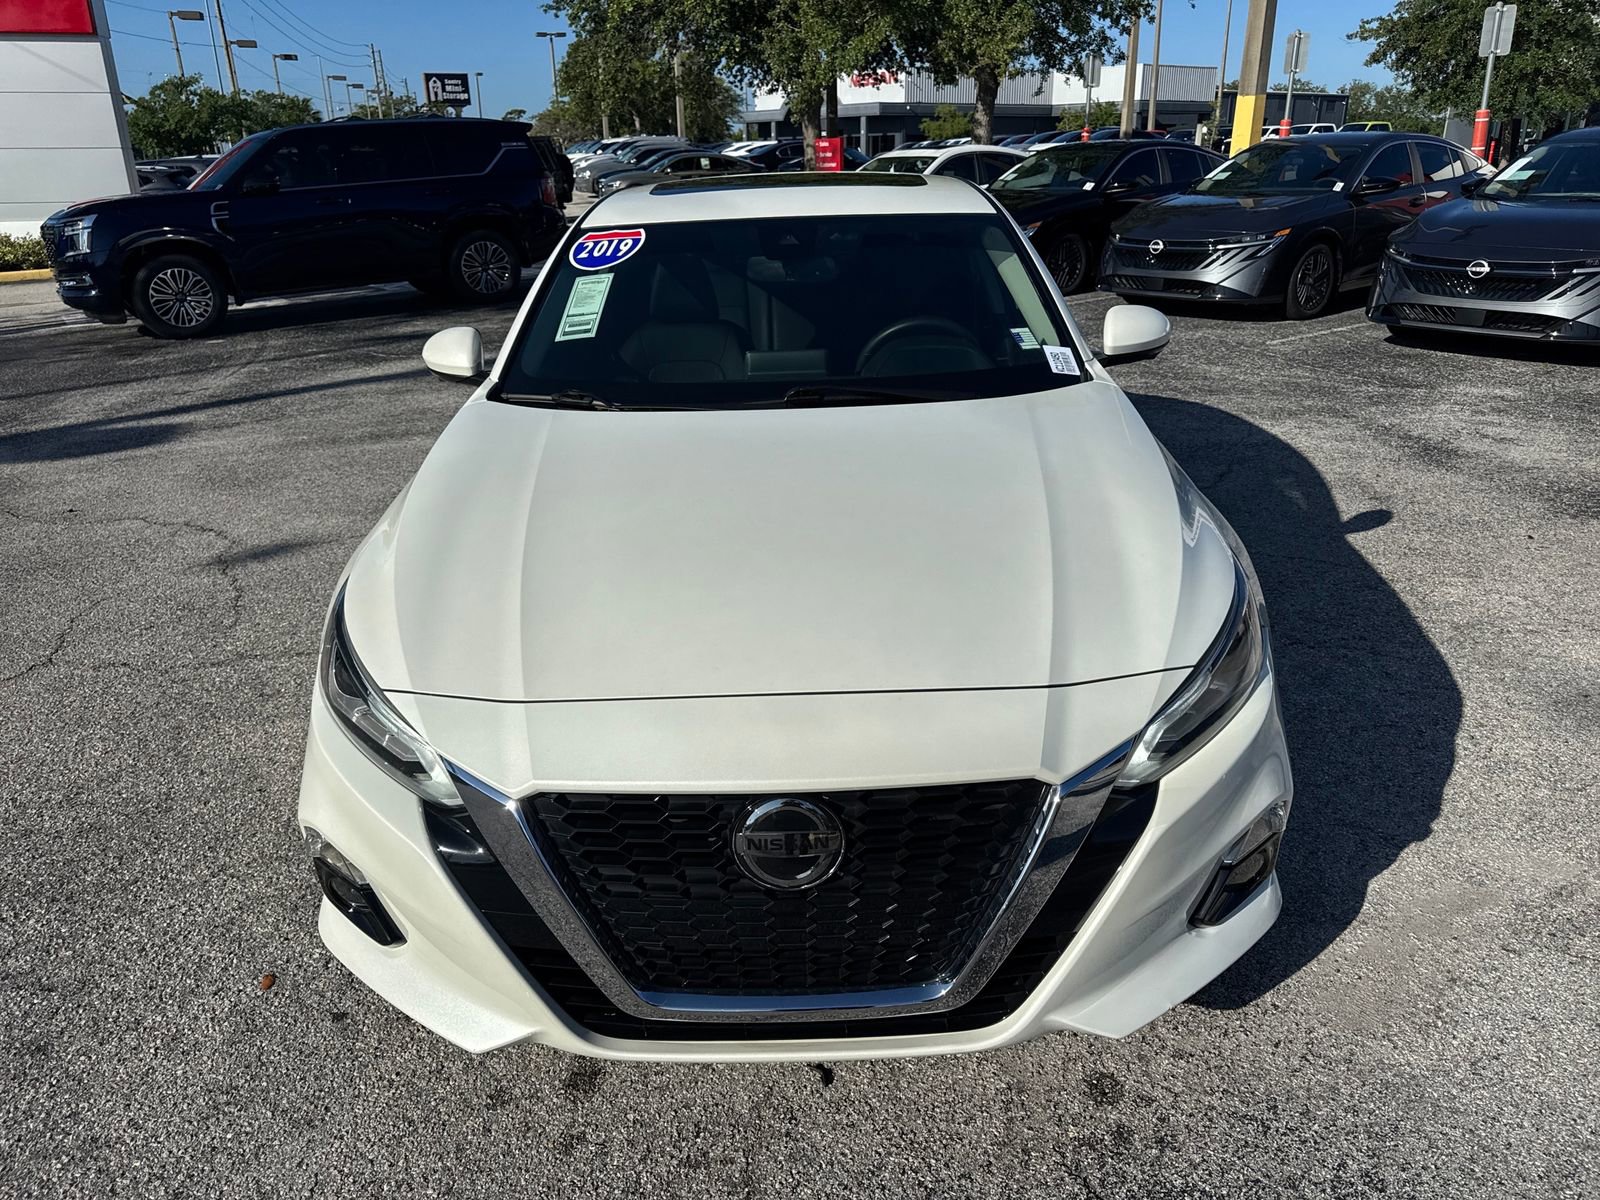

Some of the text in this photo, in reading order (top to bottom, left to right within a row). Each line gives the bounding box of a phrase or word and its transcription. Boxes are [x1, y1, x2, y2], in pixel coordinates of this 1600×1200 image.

[443, 92, 469, 100] Storage
[576, 239, 633, 258] 2019
[747, 837, 830, 851] NISSAN
